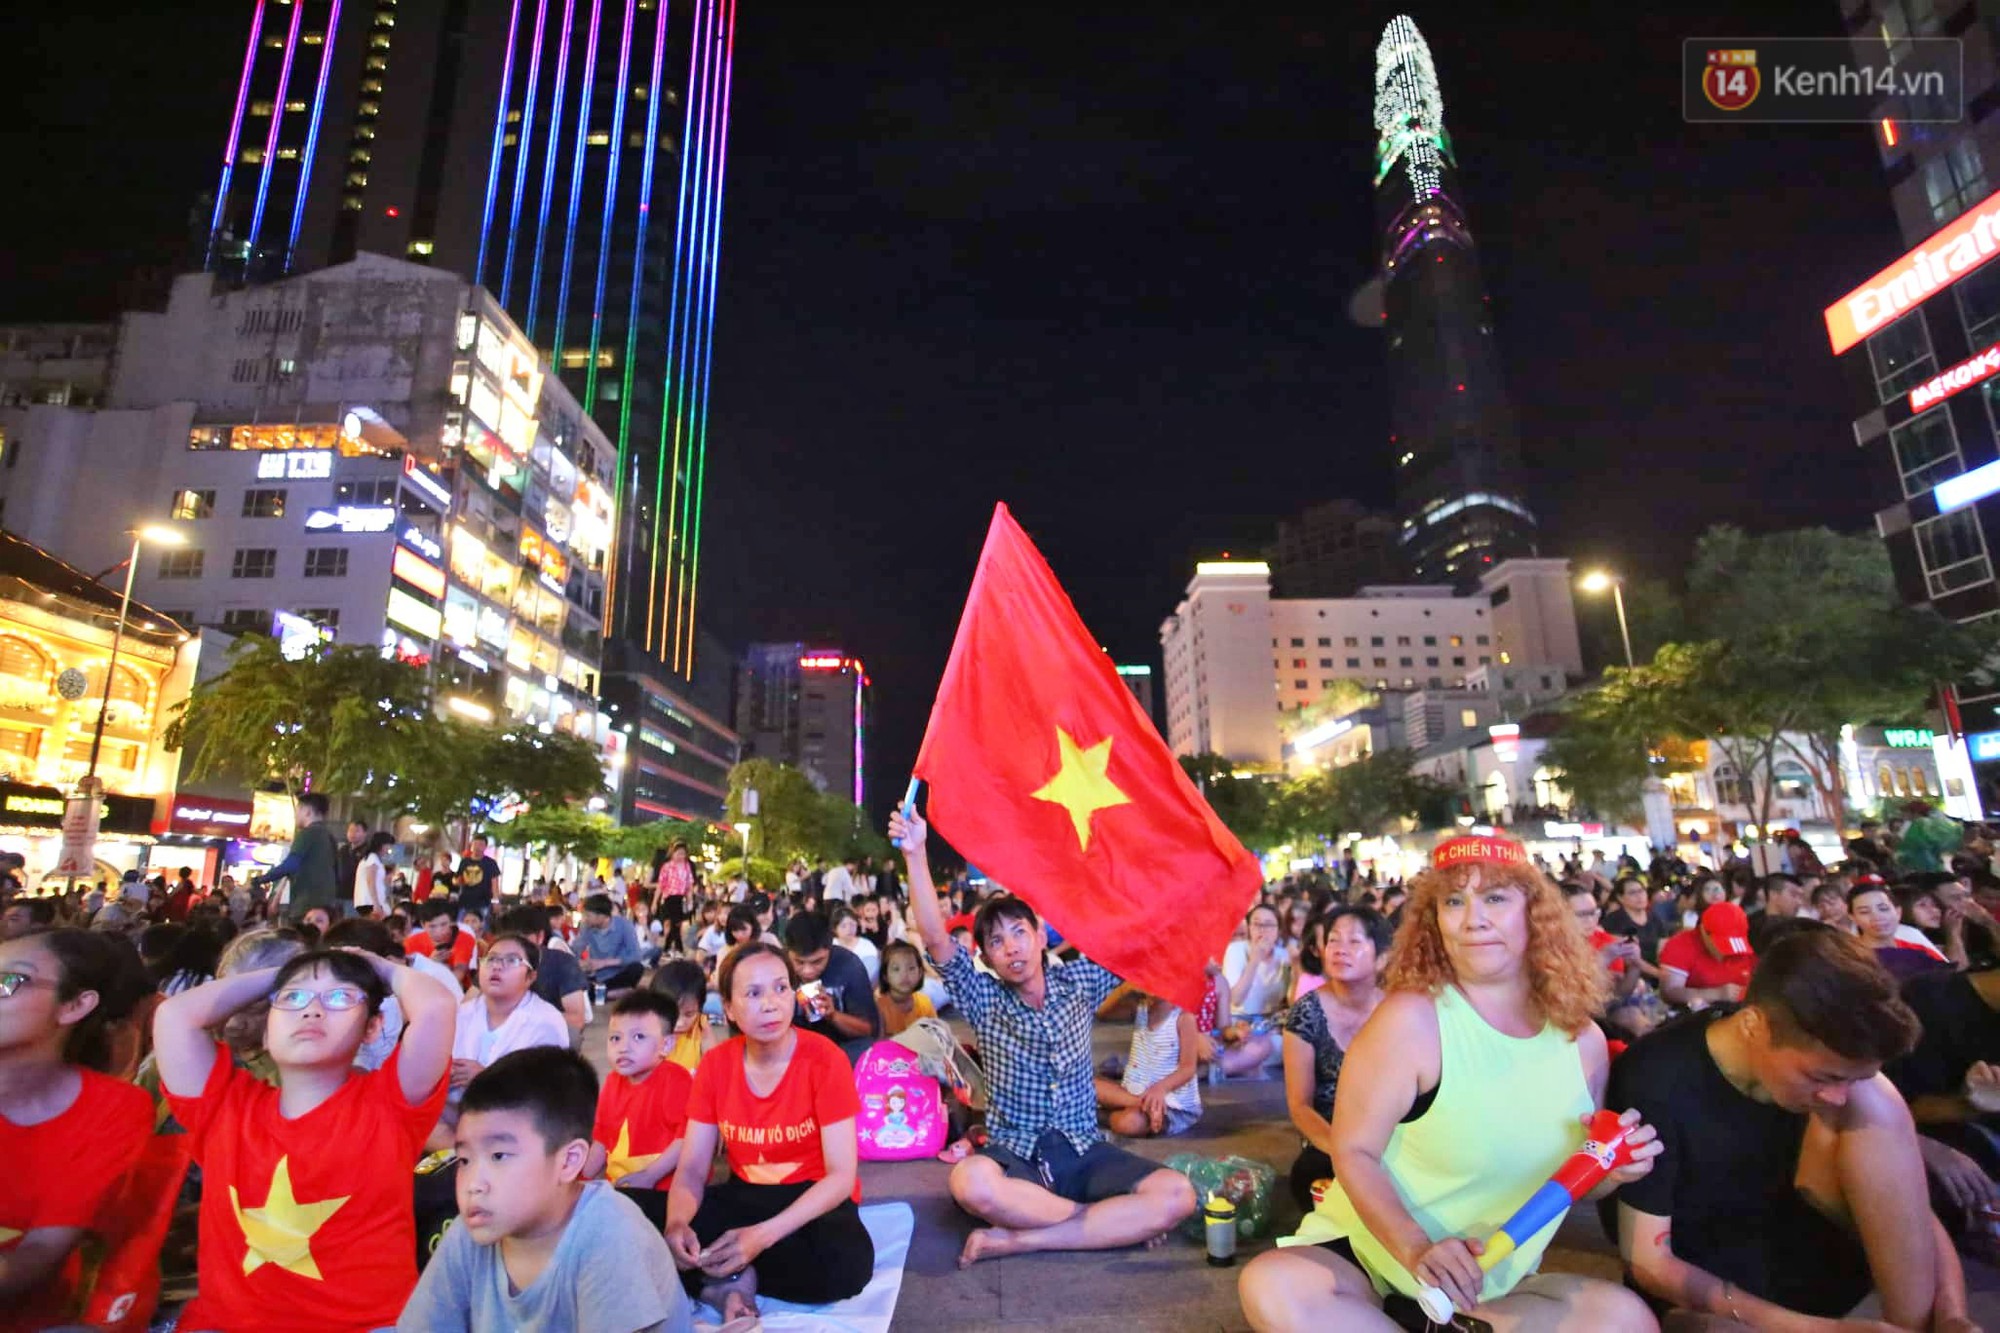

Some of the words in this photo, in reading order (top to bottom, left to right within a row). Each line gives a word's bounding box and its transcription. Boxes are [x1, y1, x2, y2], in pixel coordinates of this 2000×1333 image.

[1884, 728, 1934, 748] WRA
[1449, 839, 1491, 859] CHIẾN
[738, 1126, 765, 1144] NAM
[785, 1117, 816, 1143] ĐỊCH
